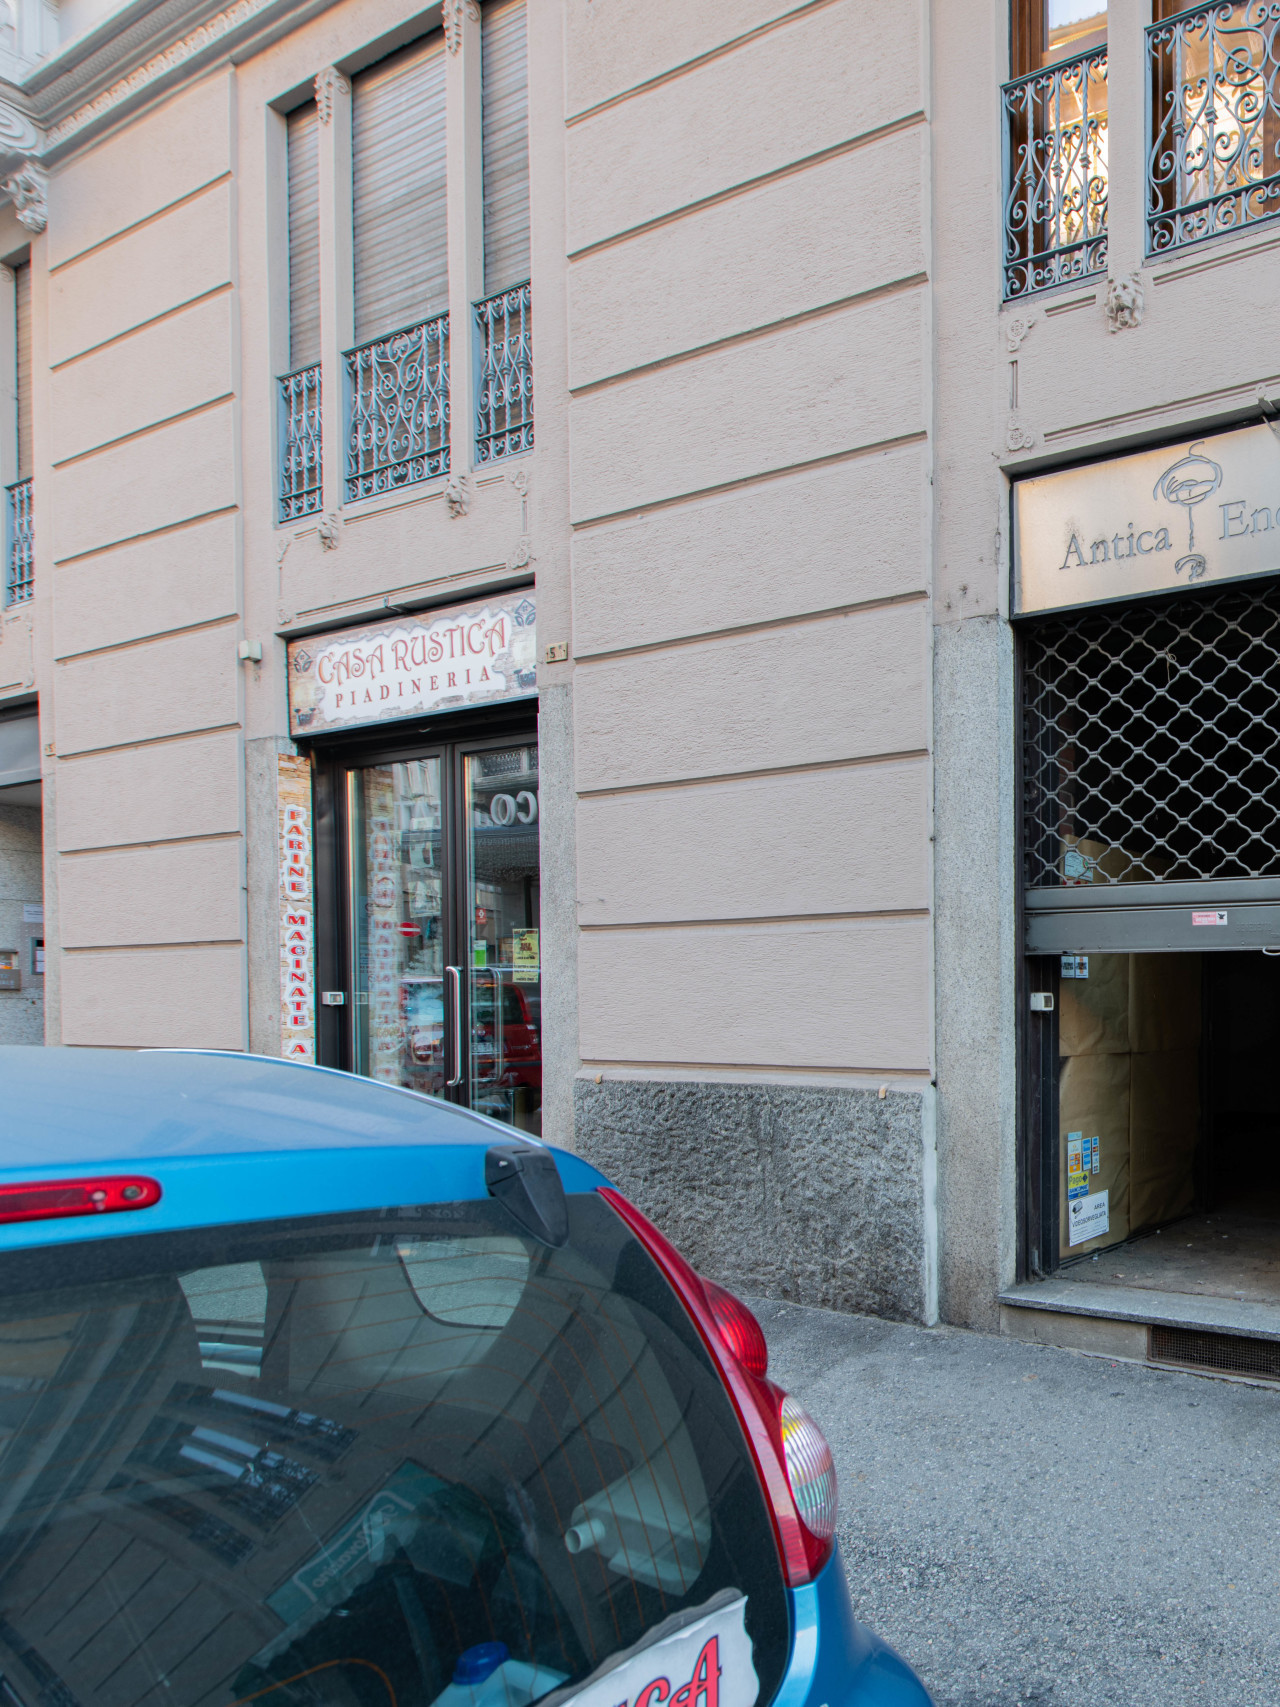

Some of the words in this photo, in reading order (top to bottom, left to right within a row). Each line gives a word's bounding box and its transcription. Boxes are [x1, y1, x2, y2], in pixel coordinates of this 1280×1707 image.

[1059, 522, 1173, 570] Antica
[317, 643, 386, 687] CASA
[390, 616, 507, 674] RUSTICA
[335, 665, 491, 709] PIADINERIA
[287, 809, 306, 893] FARINE
[287, 914, 308, 1027] MACINATE
[1094, 1202, 1106, 1211] AREA
